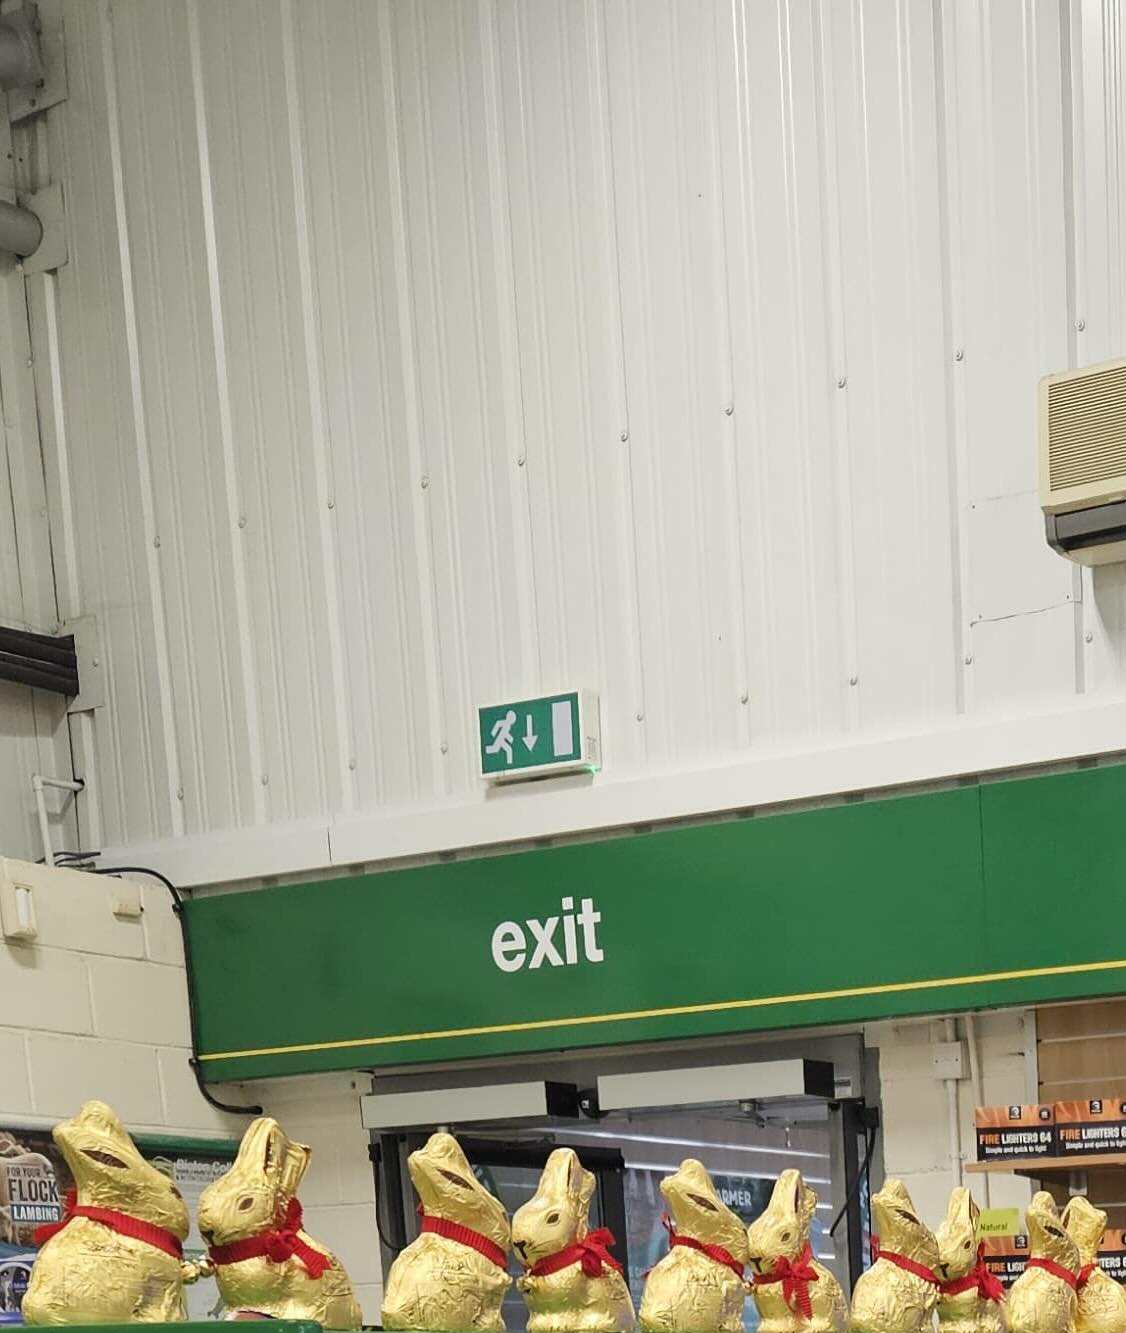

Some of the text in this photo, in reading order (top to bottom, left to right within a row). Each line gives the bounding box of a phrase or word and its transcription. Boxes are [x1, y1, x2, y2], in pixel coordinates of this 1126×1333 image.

[491, 897, 604, 973] exit
[979, 1131, 1052, 1145] FIRE LIGHTERS 64
[1060, 1128, 1080, 1140] FIRE
[1082, 1126, 1119, 1139] LIGHTERS
[7, 1167, 41, 1177] FOR YOUR
[9, 1179, 58, 1202] FLOCK
[717, 1191, 752, 1207] ARMER
[13, 1206, 59, 1221] LAMBING
[980, 1222, 1009, 1232] Natural
[986, 1261, 1005, 1271] FIRE
[1101, 1257, 1121, 1268] TERS
